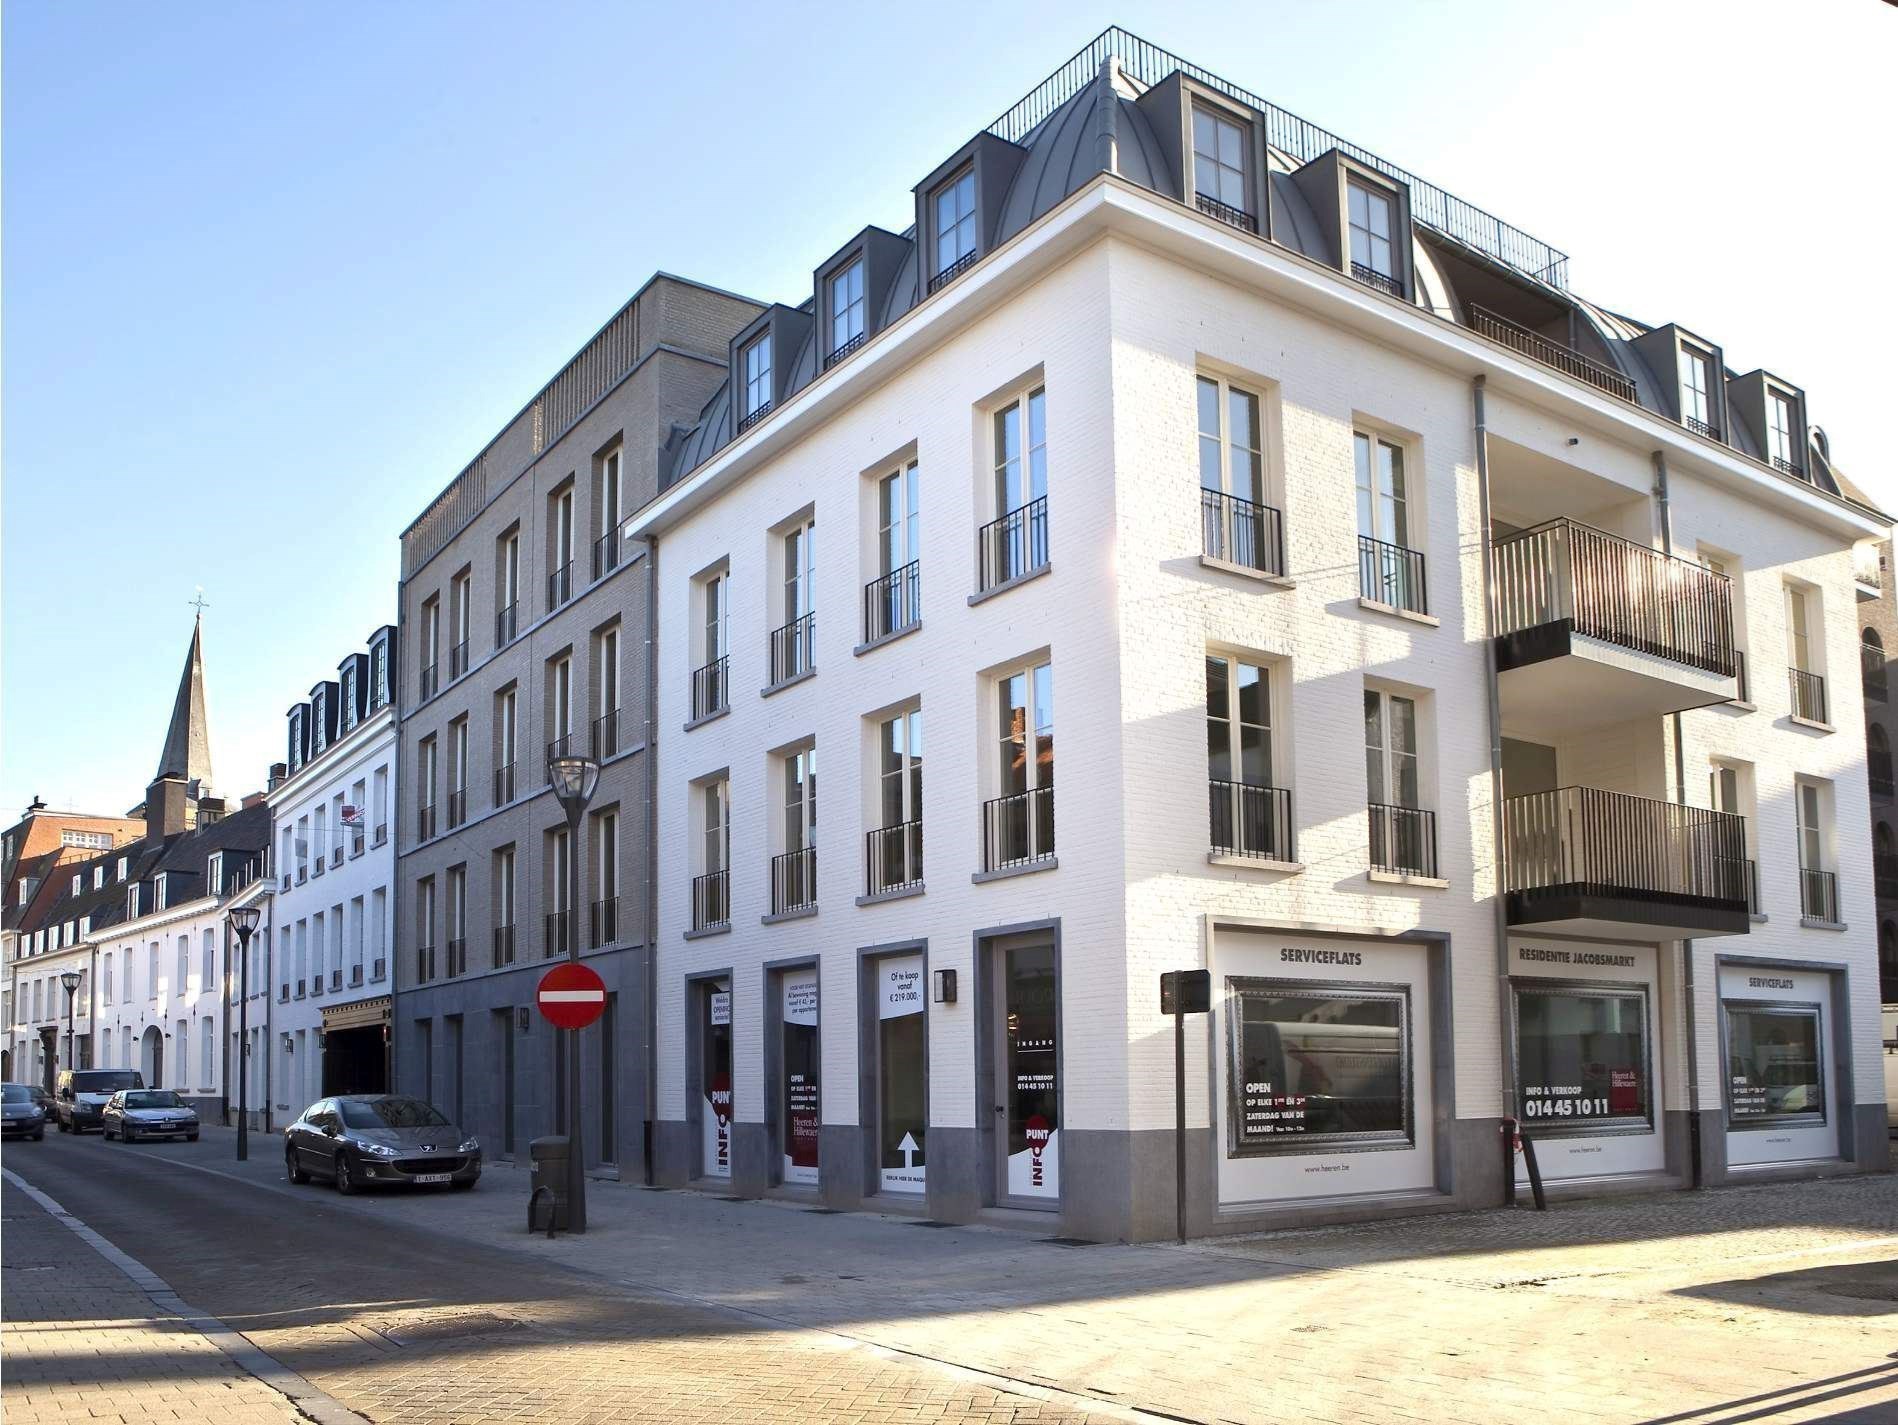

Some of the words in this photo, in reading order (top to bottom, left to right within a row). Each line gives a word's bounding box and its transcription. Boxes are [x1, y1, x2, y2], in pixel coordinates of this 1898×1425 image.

[1280, 948, 1362, 965] SERVICEFLATS
[1519, 948, 1570, 963] RESIDENTIE
[1573, 953, 1635, 967] JACOBSMARKT
[891, 972, 898, 981] Of
[905, 971, 919, 980] koop
[897, 980, 912, 990] vanaf
[1749, 977, 1793, 989] SERVICEFLATS
[890, 994, 894, 1002] €
[791, 1075, 804, 1083] OPEN
[1733, 1076, 1747, 1084] OPEN
[1246, 1083, 1271, 1093] OPEN
[1526, 1087, 1542, 1095] INFO
[1544, 1087, 1549, 1095] &
[1551, 1086, 1582, 1095] VERKOOP
[1257, 1098, 1272, 1106] ELKE
[1525, 1100, 1553, 1117] 014
[1554, 1099, 1572, 1116] 45
[1574, 1099, 1591, 1115] 10
[1593, 1098, 1608, 1114] 11
[1246, 1111, 1280, 1120] ZATERDAG
[1281, 1111, 1295, 1119] VAN
[1296, 1110, 1305, 1118] DE
[1246, 1124, 1274, 1133] MAAND!
[1026, 1129, 1049, 1140] PUNT
[1032, 1146, 1043, 1187] INFO
[1304, 1163, 1350, 1173] www.heeren.be
